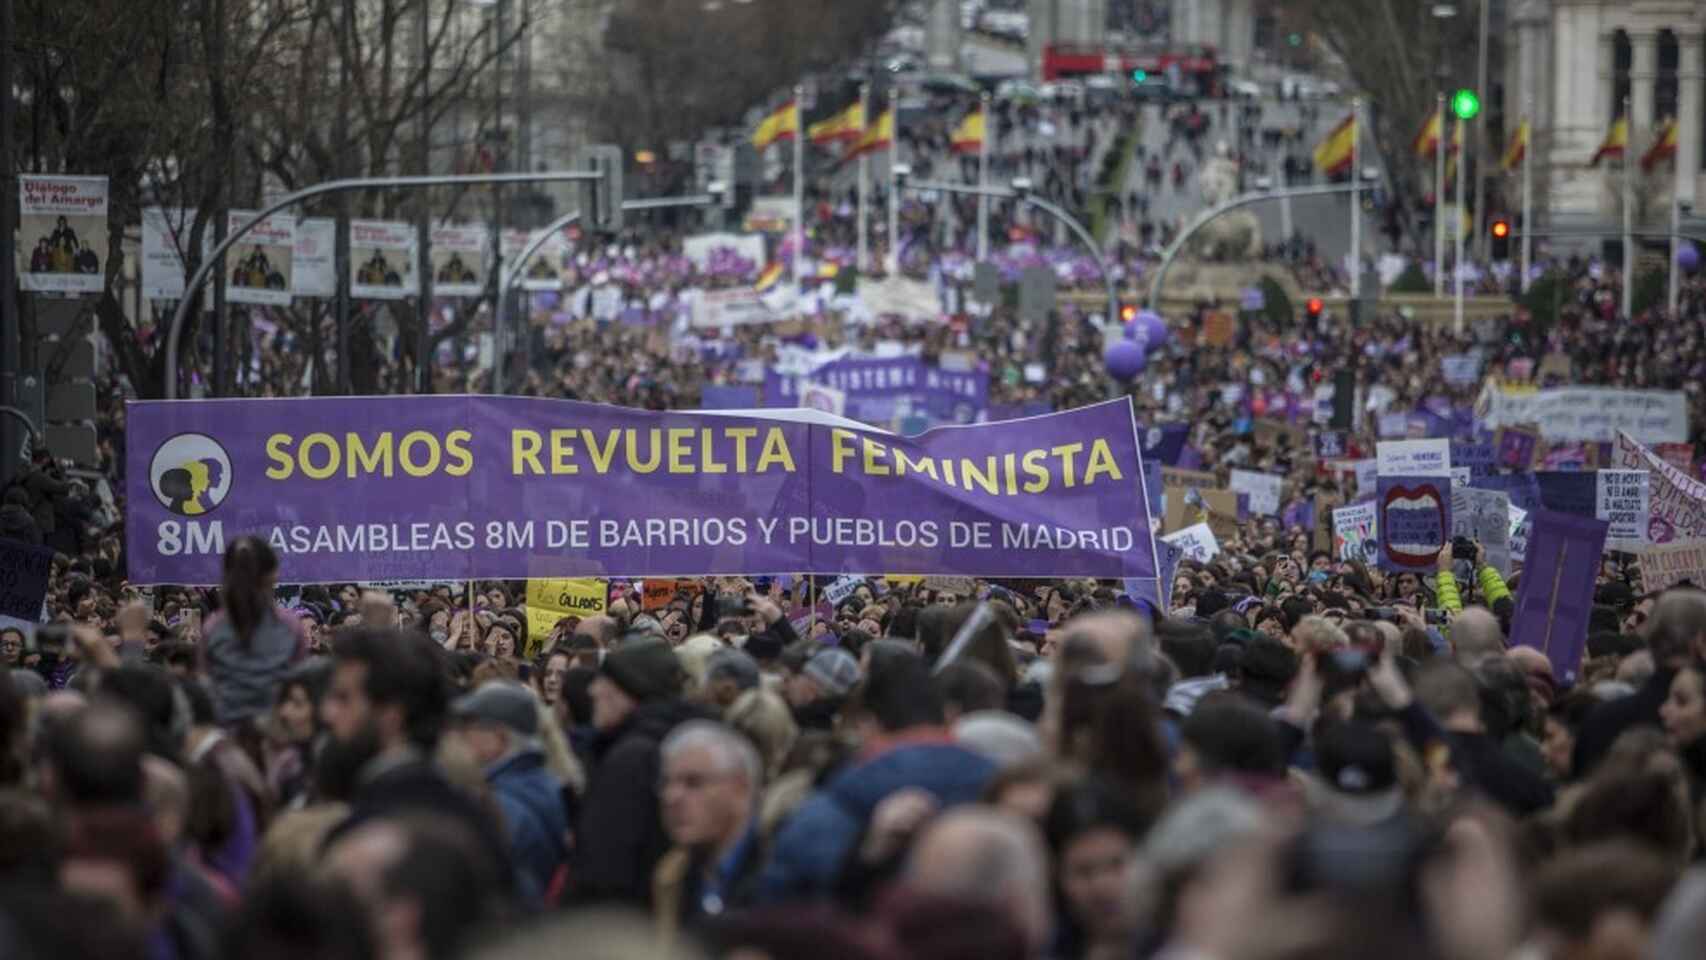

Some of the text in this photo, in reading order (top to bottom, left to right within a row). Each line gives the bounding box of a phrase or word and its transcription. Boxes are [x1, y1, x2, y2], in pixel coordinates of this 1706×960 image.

[25, 195, 104, 208] del Amargo
[265, 427, 1123, 495] SOMOS REVUELTA FEMINISTA
[156, 520, 226, 556] 8M
[269, 517, 1133, 554] ASAMBLEAS 8M DE BARRIOS Y PUEBLOS DE MADRID
[558, 591, 604, 612] CALLADAS
